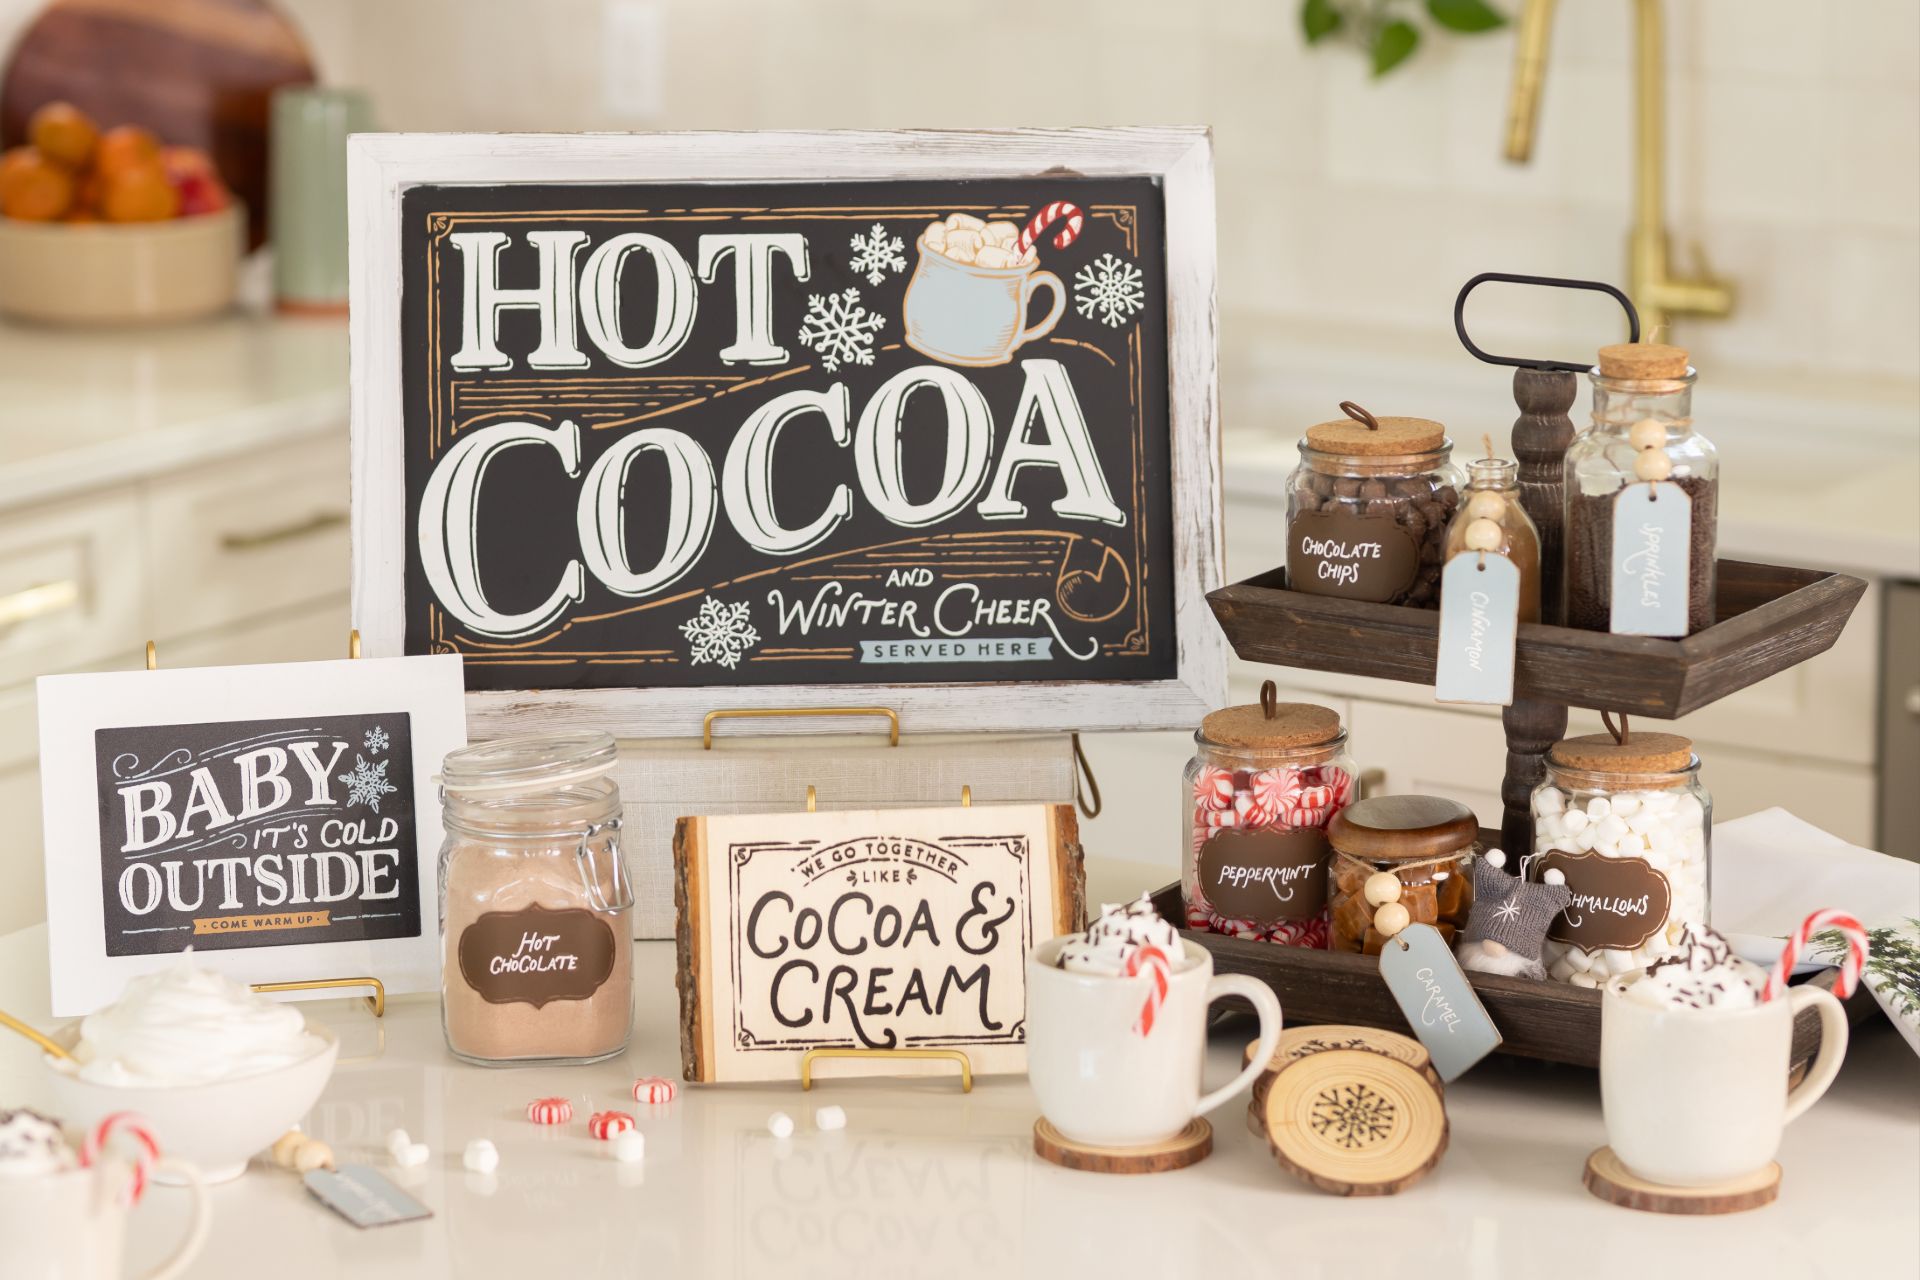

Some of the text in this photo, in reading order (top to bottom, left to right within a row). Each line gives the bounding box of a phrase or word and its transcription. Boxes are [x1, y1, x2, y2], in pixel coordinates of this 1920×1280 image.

[449, 230, 811, 373] HOT
[418, 359, 1127, 639] COCOA
[1301, 536, 1382, 559] CHOCOLATE
[1623, 522, 1665, 609] SPRINKLES
[885, 568, 934, 587] AND
[1317, 561, 1359, 586] CHIPS
[767, 581, 1098, 661] WINTER CHEER
[1465, 591, 1492, 672] CINNAMON
[873, 642, 1038, 658] SERVED HERE
[117, 740, 349, 853] BABY
[253, 818, 399, 850] IT'S COLD
[801, 842, 958, 878] WE GO TOGETHER
[863, 869, 900, 883] LIKE
[118, 848, 400, 916] OUTSIDE
[1217, 863, 1317, 902] PEPPERMINT
[211, 915, 313, 930] COME WARM UP
[747, 881, 1015, 959] COCOA &
[517, 931, 561, 958] HOT
[489, 954, 579, 975] CHOCOLATE
[770, 958, 1003, 1049] CREAM
[1416, 967, 1462, 1033] CARAMEL
